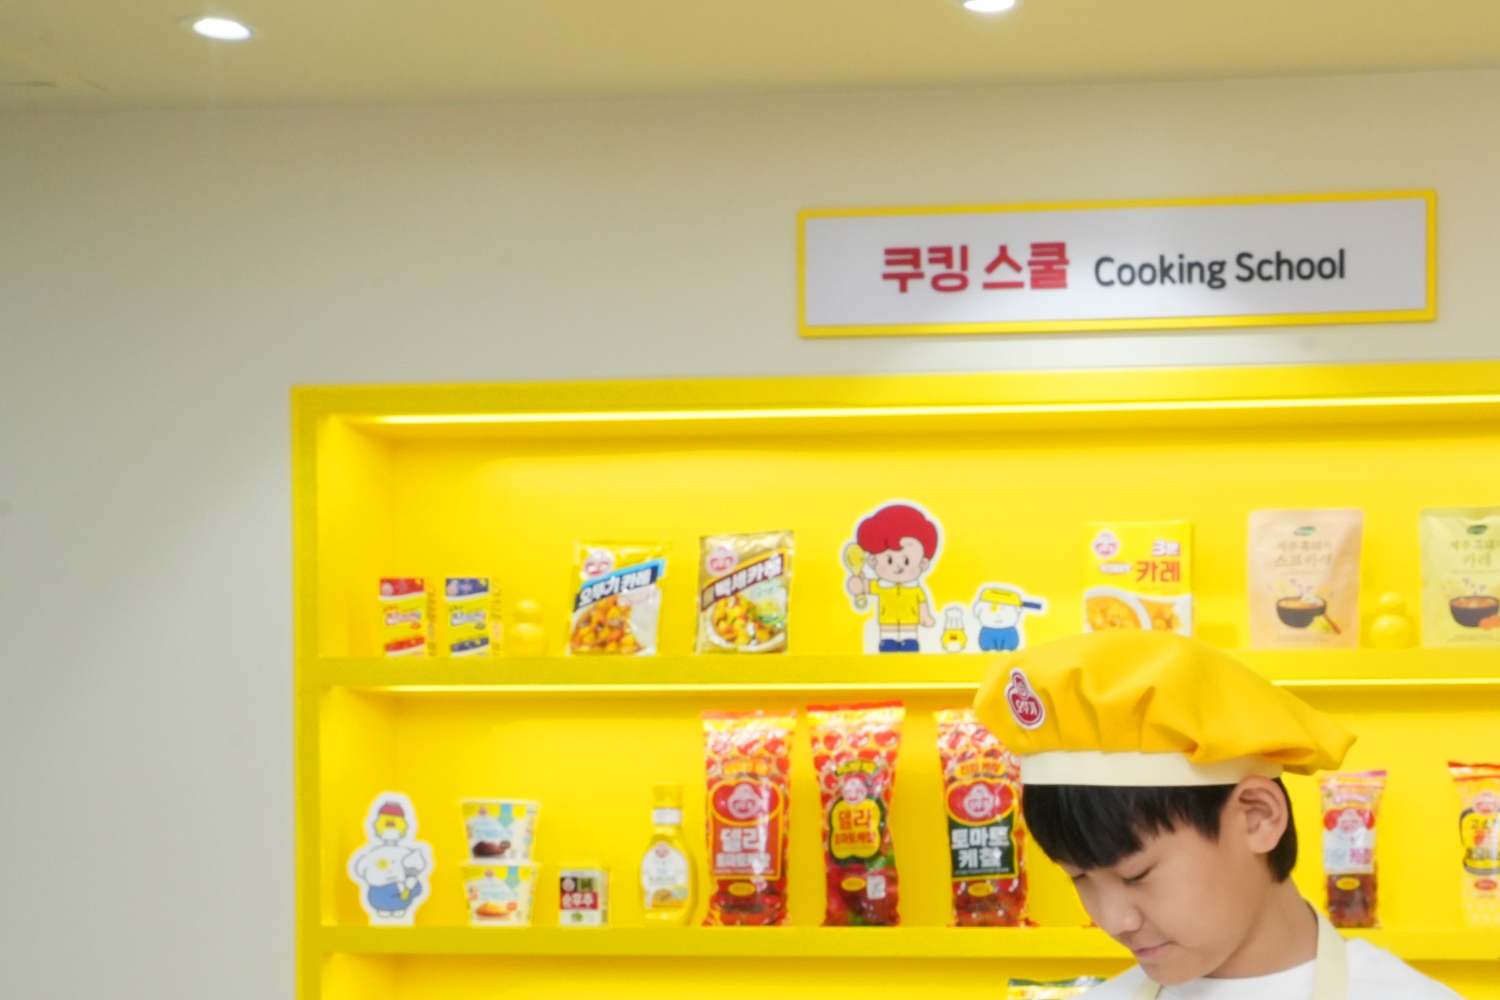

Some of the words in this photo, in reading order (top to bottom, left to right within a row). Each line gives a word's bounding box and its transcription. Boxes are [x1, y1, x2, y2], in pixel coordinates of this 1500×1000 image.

[881, 244, 970, 294] 쿠킹
[982, 241, 1071, 291] 스쿨
[1094, 252, 1227, 290] Cooking
[1234, 247, 1346, 283] School
[1135, 559, 1181, 583] 카레
[950, 825, 1010, 850] 토마토
